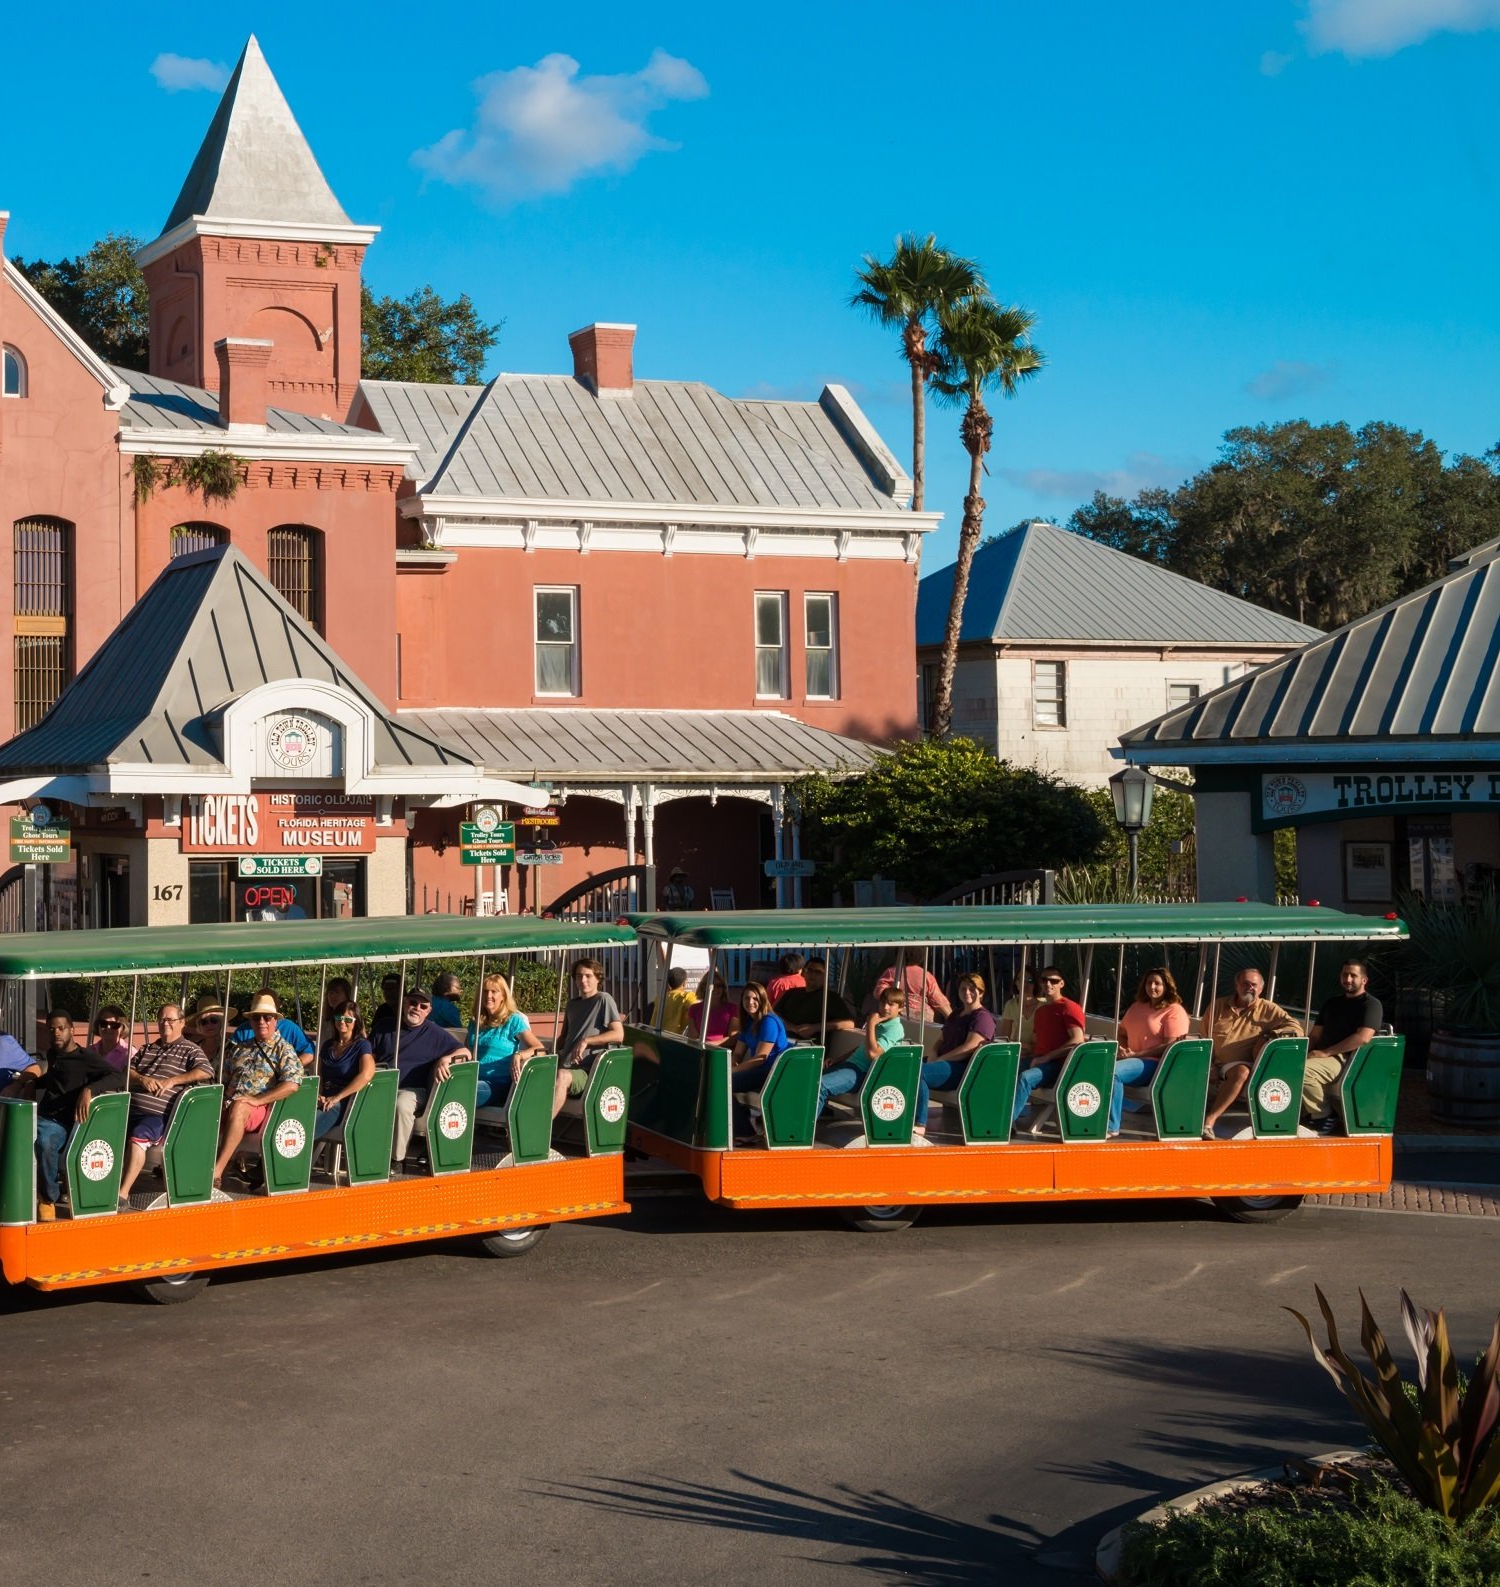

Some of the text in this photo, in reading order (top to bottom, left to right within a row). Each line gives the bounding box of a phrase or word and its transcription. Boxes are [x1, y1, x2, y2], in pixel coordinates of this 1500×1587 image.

[278, 752, 310, 766] TOURS
[270, 794, 372, 805] HISTORIC OLD JAIL
[1334, 776, 1474, 808] TROLLEY
[190, 794, 258, 846] TICKETS
[278, 818, 366, 828] FLORIDA HERITAGE
[283, 830, 362, 846] MUSEUM
[262, 858, 300, 866] TICKETS
[256, 866, 304, 874] SOLD HERE
[153, 885, 183, 901] 167
[245, 887, 294, 906] OPEN
